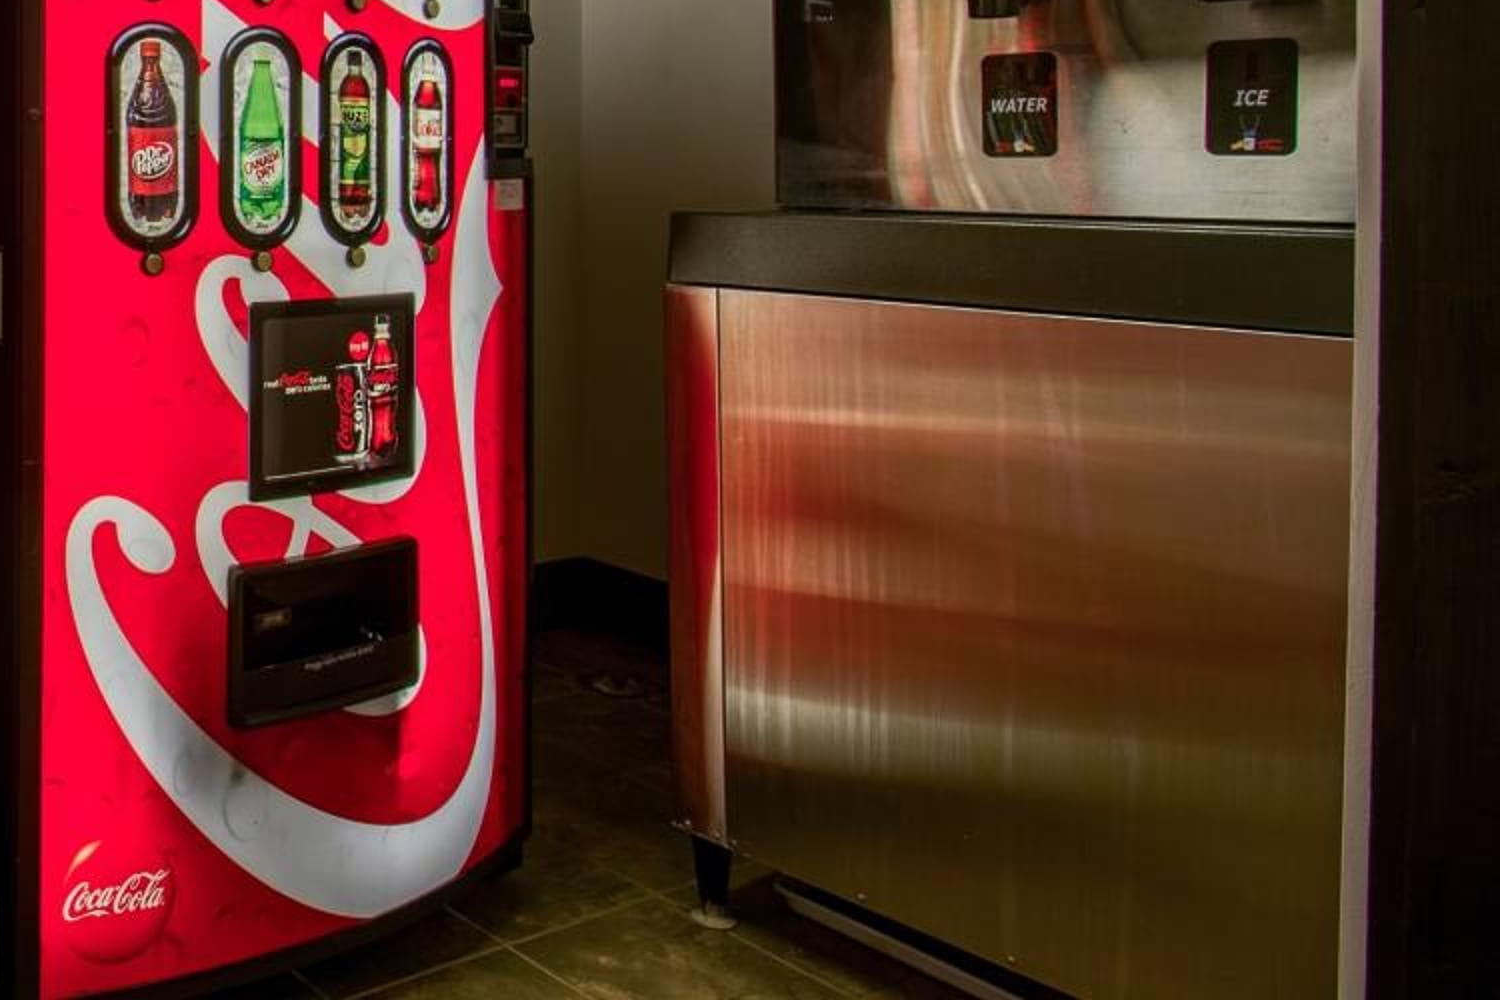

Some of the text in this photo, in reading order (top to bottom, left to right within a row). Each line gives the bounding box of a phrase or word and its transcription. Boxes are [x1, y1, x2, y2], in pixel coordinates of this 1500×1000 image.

[990, 97, 1048, 113] WATER
[1232, 88, 1270, 107] ICE
[63, 870, 171, 922] Coca-Cola
